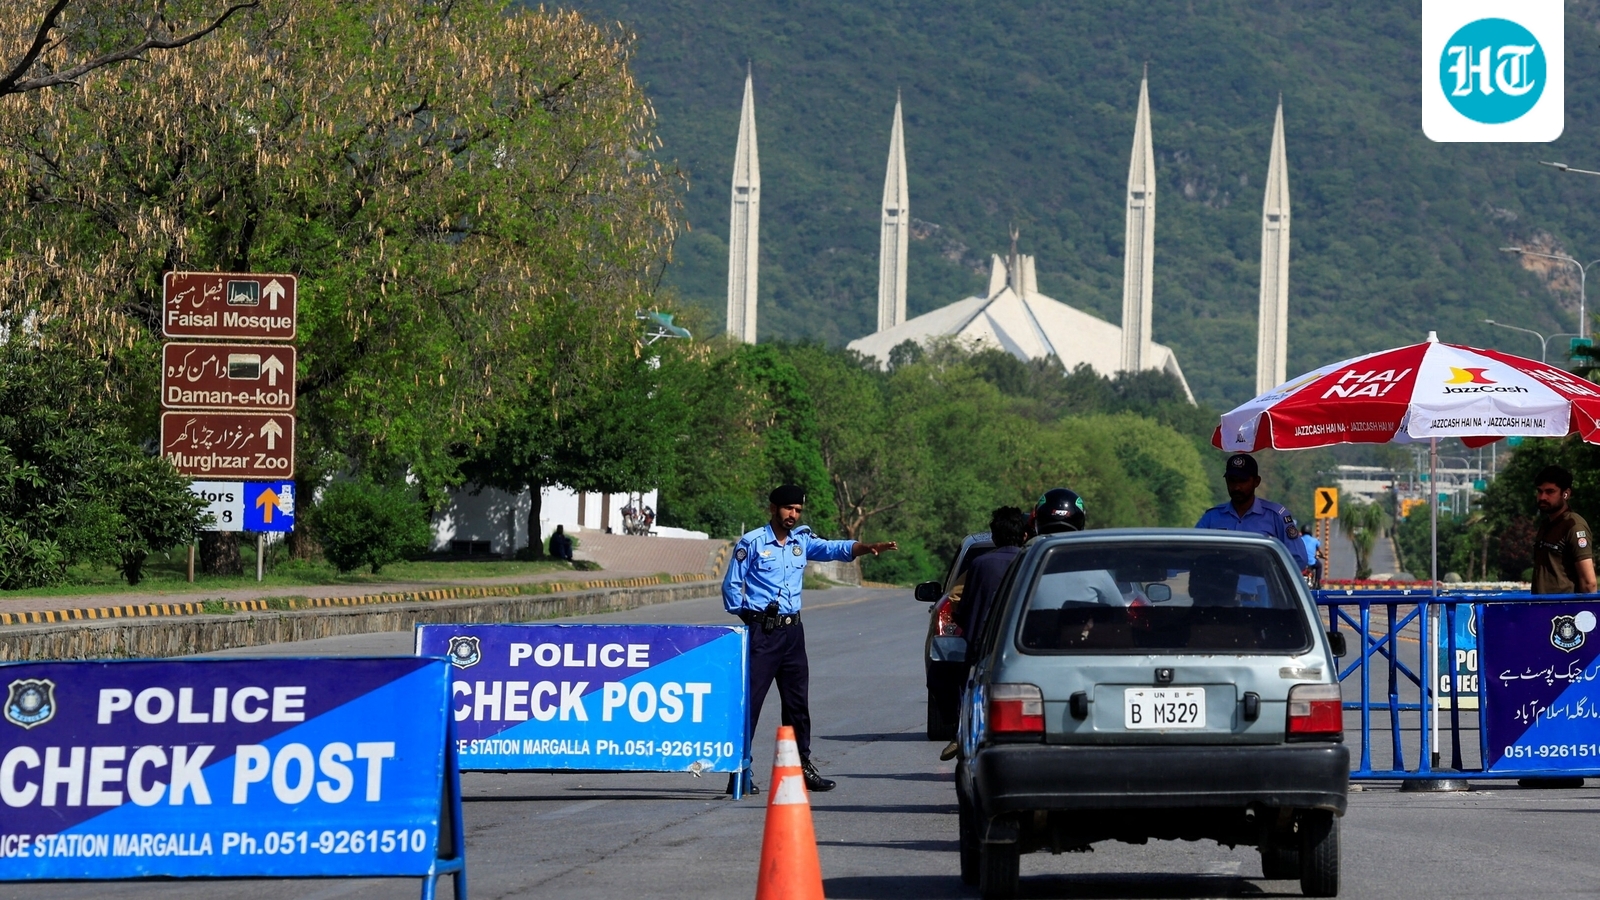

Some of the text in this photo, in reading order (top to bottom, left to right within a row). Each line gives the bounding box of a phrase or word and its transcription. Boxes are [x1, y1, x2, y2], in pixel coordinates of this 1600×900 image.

[168, 278, 223, 309] فیصل مسجد
[168, 311, 292, 332] Faisal Mosque
[187, 354, 227, 382] دامن
[1337, 368, 1413, 384] HAI
[168, 386, 290, 405] Daman-e-koh
[1320, 383, 1397, 399] NA!
[1442, 385, 1529, 394] JazzCash
[166, 418, 197, 448] گھر
[1294, 424, 1325, 437] JAZZCASH
[1326, 423, 1337, 434] HAI
[1337, 422, 1346, 433] NA
[1350, 421, 1378, 432] JAZZCASH
[1430, 417, 1546, 429] JAZZCASH HAI NA JAZZCASH HAI NA!
[215, 425, 254, 449] مرغزار
[167, 452, 289, 471] Murghzar Zoo
[509, 643, 650, 668] POLICE
[1455, 649, 1478, 672] PO
[97, 686, 307, 725] POLICE
[452, 681, 712, 723] CHECK POST
[1131, 703, 1198, 724] B M329
[470, 739, 520, 755] STATION
[523, 739, 590, 755] MARGALLA
[596, 739, 734, 758] Ph.051-9261510
[1504, 744, 1600, 758] 051-926151
[0, 741, 396, 807] CHECK POST
[0, 829, 427, 858] ICE STATION MARGALLA Ph.051-9261510
